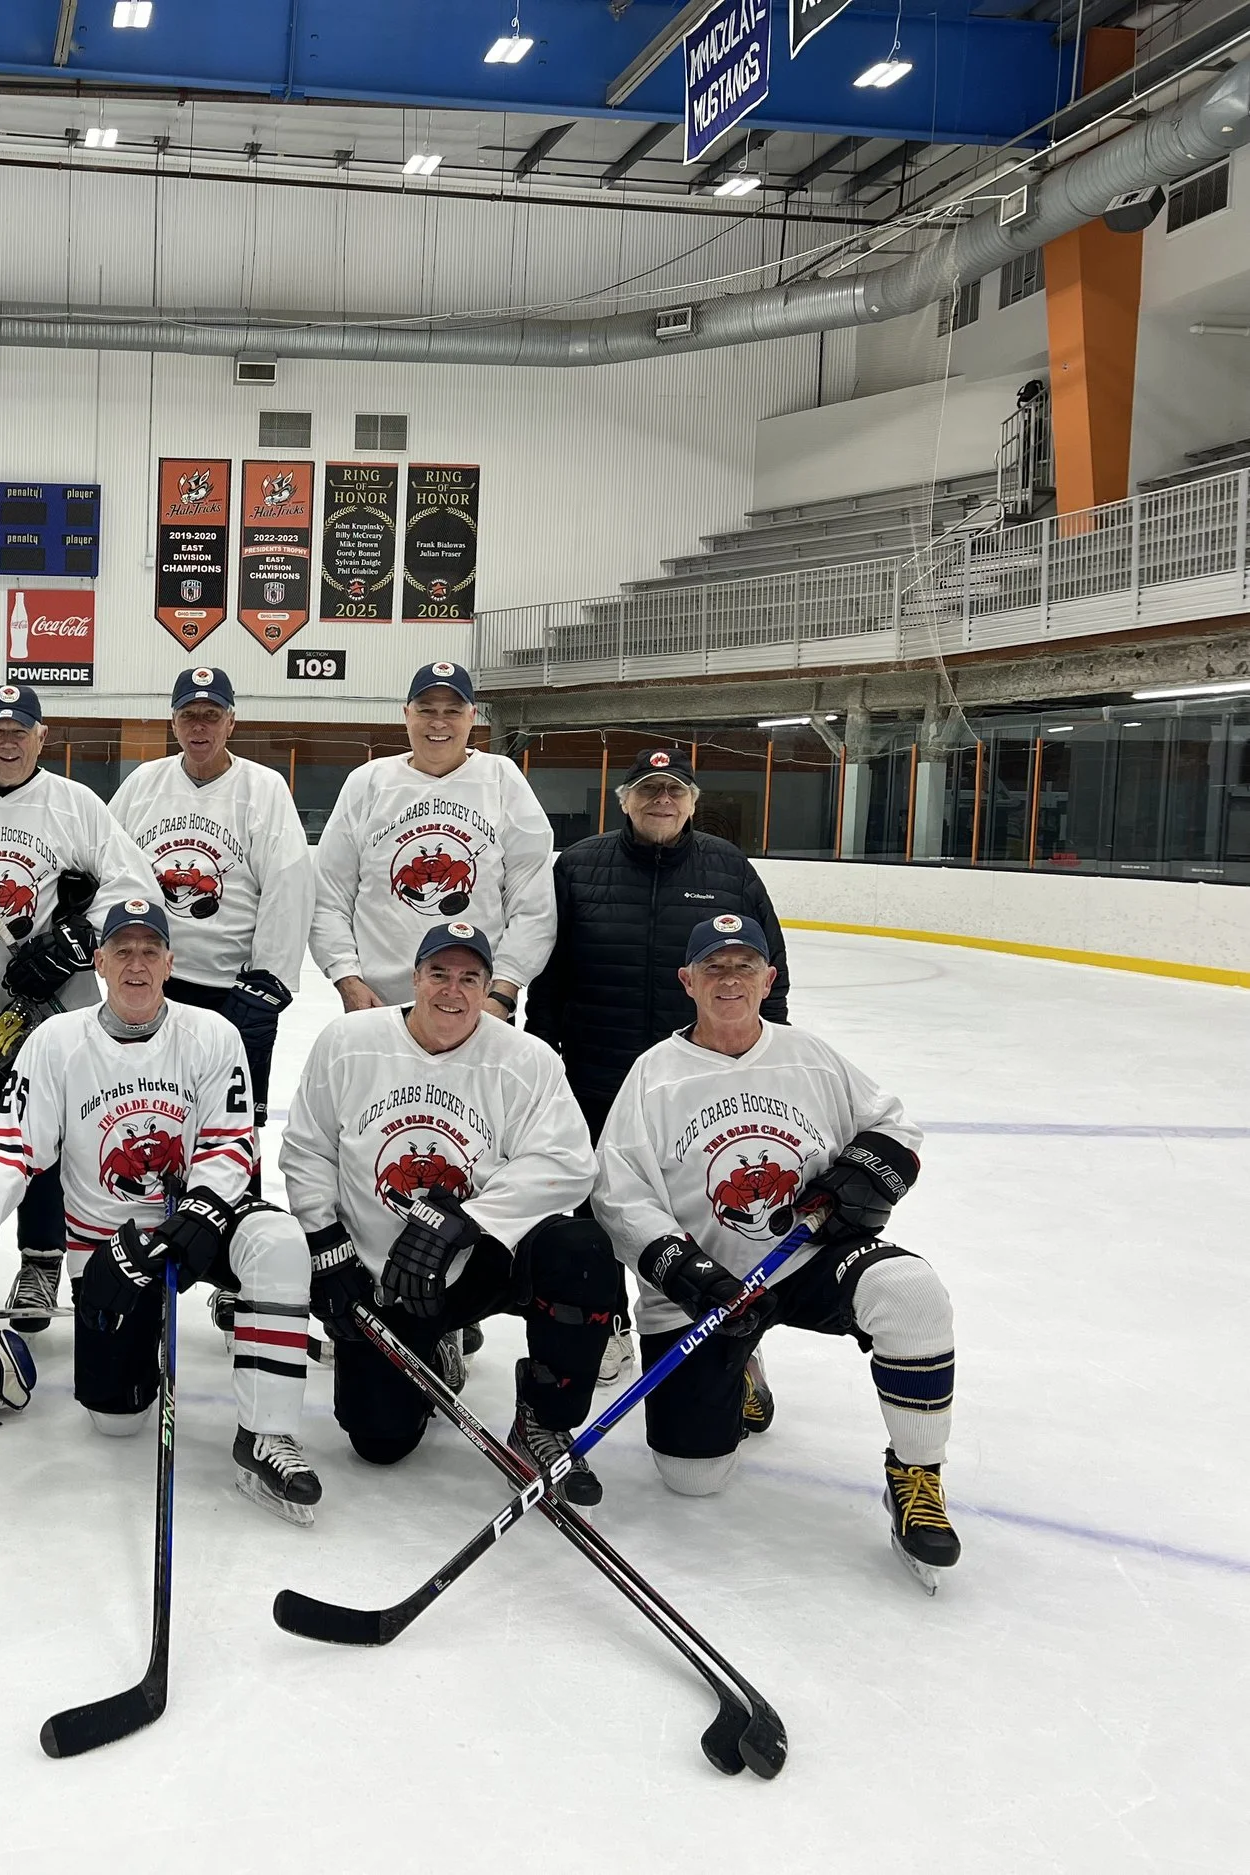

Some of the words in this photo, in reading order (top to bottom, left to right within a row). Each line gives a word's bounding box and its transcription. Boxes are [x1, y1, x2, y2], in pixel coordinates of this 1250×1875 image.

[694, 42, 760, 136] MUSTANGS
[343, 469, 381, 482] RING
[425, 470, 462, 483] RING
[355, 482, 367, 491] OF
[437, 484, 449, 492] OF
[7, 487, 38, 499] penalty
[67, 488, 94, 500] player
[334, 491, 387, 505] HONOR
[416, 493, 469, 506] HONOR
[7, 533, 38, 545] penalty
[66, 534, 93, 546] player
[169, 532, 216, 540] 2019-2020
[254, 534, 298, 542] 2022-2023
[244, 546, 281, 554] PRESIDENTS
[283, 546, 308, 555] TROPHY
[339, 540, 355, 548] Mike
[357, 541, 378, 549] Brown
[163, 565, 221, 573] CHAMPIONS
[250, 572, 300, 580] CHAMPIONS
[335, 604, 377, 618] 2025
[418, 604, 459, 618] 2026
[295, 658, 337, 676] 109
[8, 668, 89, 680] POWERADE
[358, 1101, 387, 1136] OLDE
[386, 1084, 421, 1111] CRABS
[425, 1083, 466, 1121] HOCKEY
[675, 1120, 700, 1164] OLDE
[700, 1096, 738, 1130] CRABS
[741, 1092, 790, 1122] HOCKEY
[792, 1107, 826, 1150] CLUB
[703, 1136, 727, 1156] THE
[727, 1124, 758, 1138] OLDE
[761, 1125, 802, 1148] CRABS
[680, 1267, 766, 1355] ULTRALIGHT
